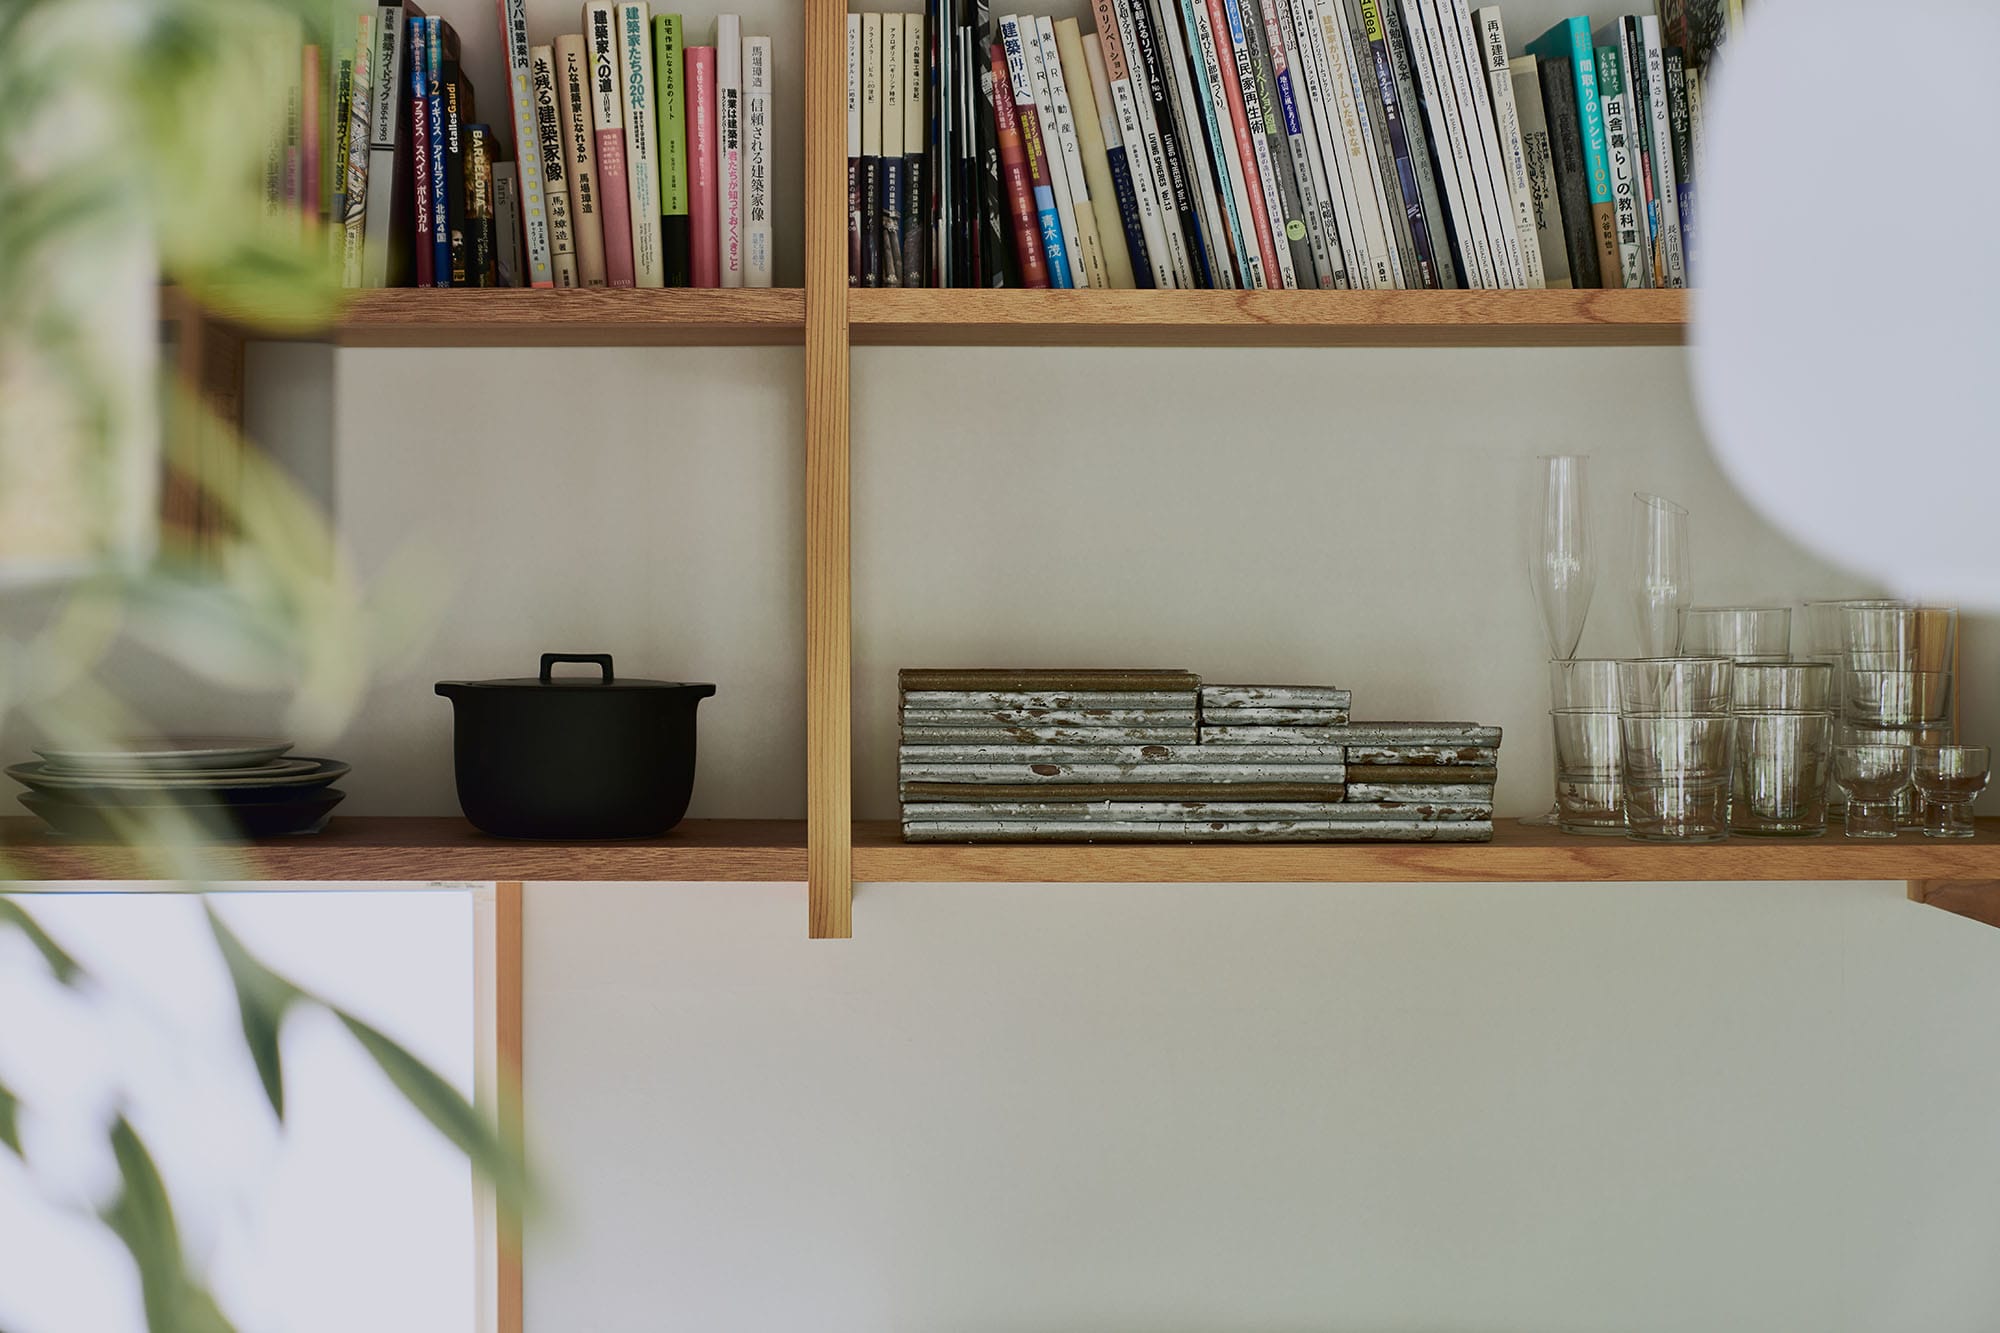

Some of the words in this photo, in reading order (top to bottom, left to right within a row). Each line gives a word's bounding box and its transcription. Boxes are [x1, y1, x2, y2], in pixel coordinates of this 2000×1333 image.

[593, 10, 613, 93] 建築家への道
[625, 6, 645, 110] 建築家たちの20代
[1364, 7, 1377, 35] idea
[1487, 19, 1505, 68] 再生建築
[431, 80, 440, 96] 2
[664, 19, 675, 120] 住宅作家になるためのノート
[1001, 21, 1031, 98] 建築再生へ
[1235, 48, 1264, 135] 古民家再生術
[1648, 48, 1665, 120] 風景にさわる
[1666, 55, 1688, 133] 造園を読む
[533, 58, 564, 182] 生残る建築家像
[567, 53, 588, 163] こんな建築家になれるか
[727, 88, 738, 150] 職業は建築家
[1148, 132, 1159, 155] LIVING
[1164, 133, 1175, 156] LIVING
[1579, 59, 1602, 150] 間取りのレシピ
[1594, 154, 1607, 196] 100
[472, 130, 486, 208] BARCELONA
[497, 178, 506, 206] Paris
[751, 97, 765, 222] 信頼される建築家像
[1153, 156, 1167, 188] SPHERES
[1169, 157, 1183, 189] SPHERES
[1607, 102, 1636, 244] 田舎暮らしの教科書
[1041, 214, 1059, 241] 青木
[1047, 243, 1062, 258] 茂
